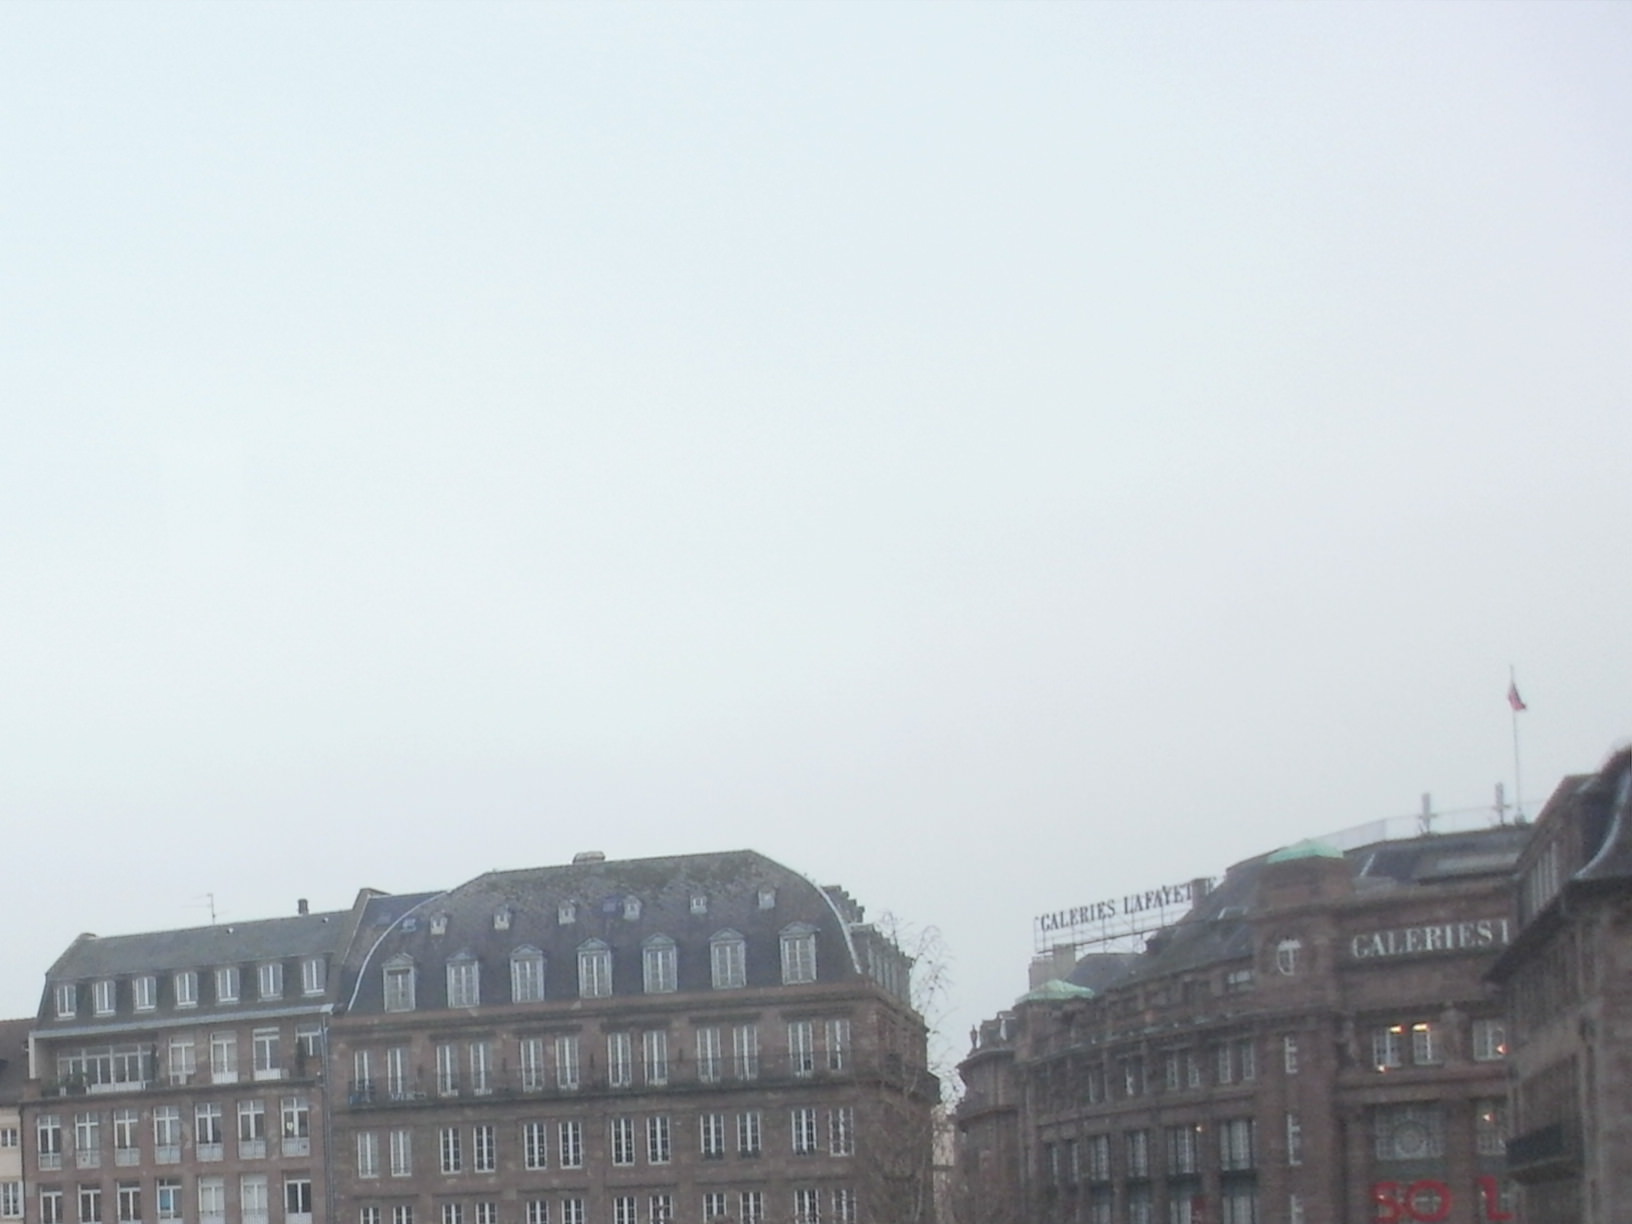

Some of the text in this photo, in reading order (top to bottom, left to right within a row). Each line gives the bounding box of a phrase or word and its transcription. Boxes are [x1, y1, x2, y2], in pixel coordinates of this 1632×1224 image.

[1041, 877, 1217, 932] GALERIES LAFAYETE
[1352, 919, 1493, 959] GALERIES
